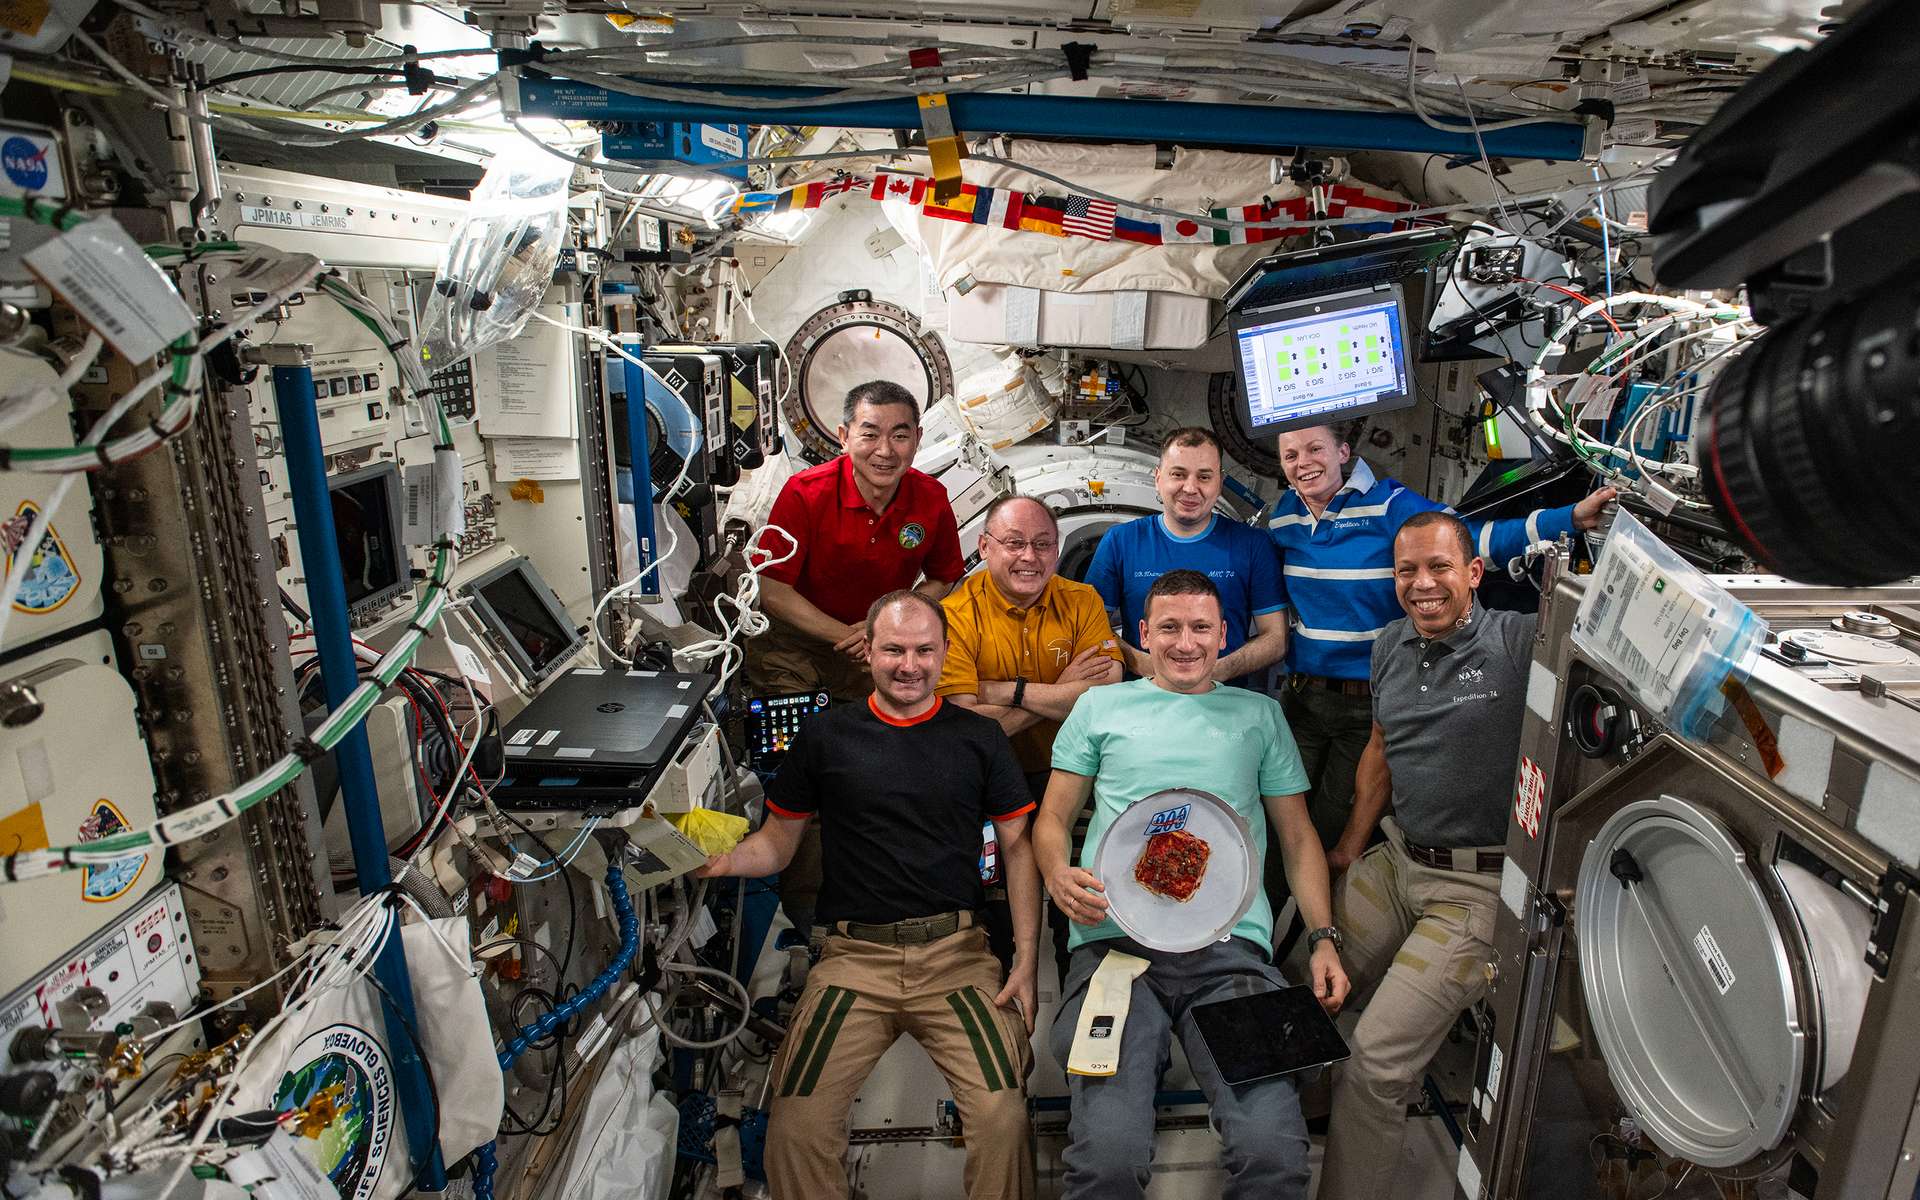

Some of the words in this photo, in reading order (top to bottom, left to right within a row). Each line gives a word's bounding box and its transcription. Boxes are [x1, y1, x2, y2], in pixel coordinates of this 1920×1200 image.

[5, 155, 46, 173] NASA
[252, 208, 293, 225] JPM1A6
[310, 215, 348, 229] JEMRMS
[1345, 371, 1357, 379] S/G
[1373, 365, 1384, 374] S/G
[1284, 383, 1296, 391] S/G
[1312, 378, 1324, 386] S/G
[1334, 520, 1360, 529] Expedition
[1459, 669, 1484, 681] NASA
[1453, 693, 1487, 703] Expedition
[1527, 772, 1535, 792] FIRE
[1524, 795, 1532, 822] PORT
[51, 969, 67, 986] JEM
[62, 983, 74, 995] ON
[322, 1032, 379, 1068] GLOVEBOX
[371, 1066, 391, 1158] SCIENCES
